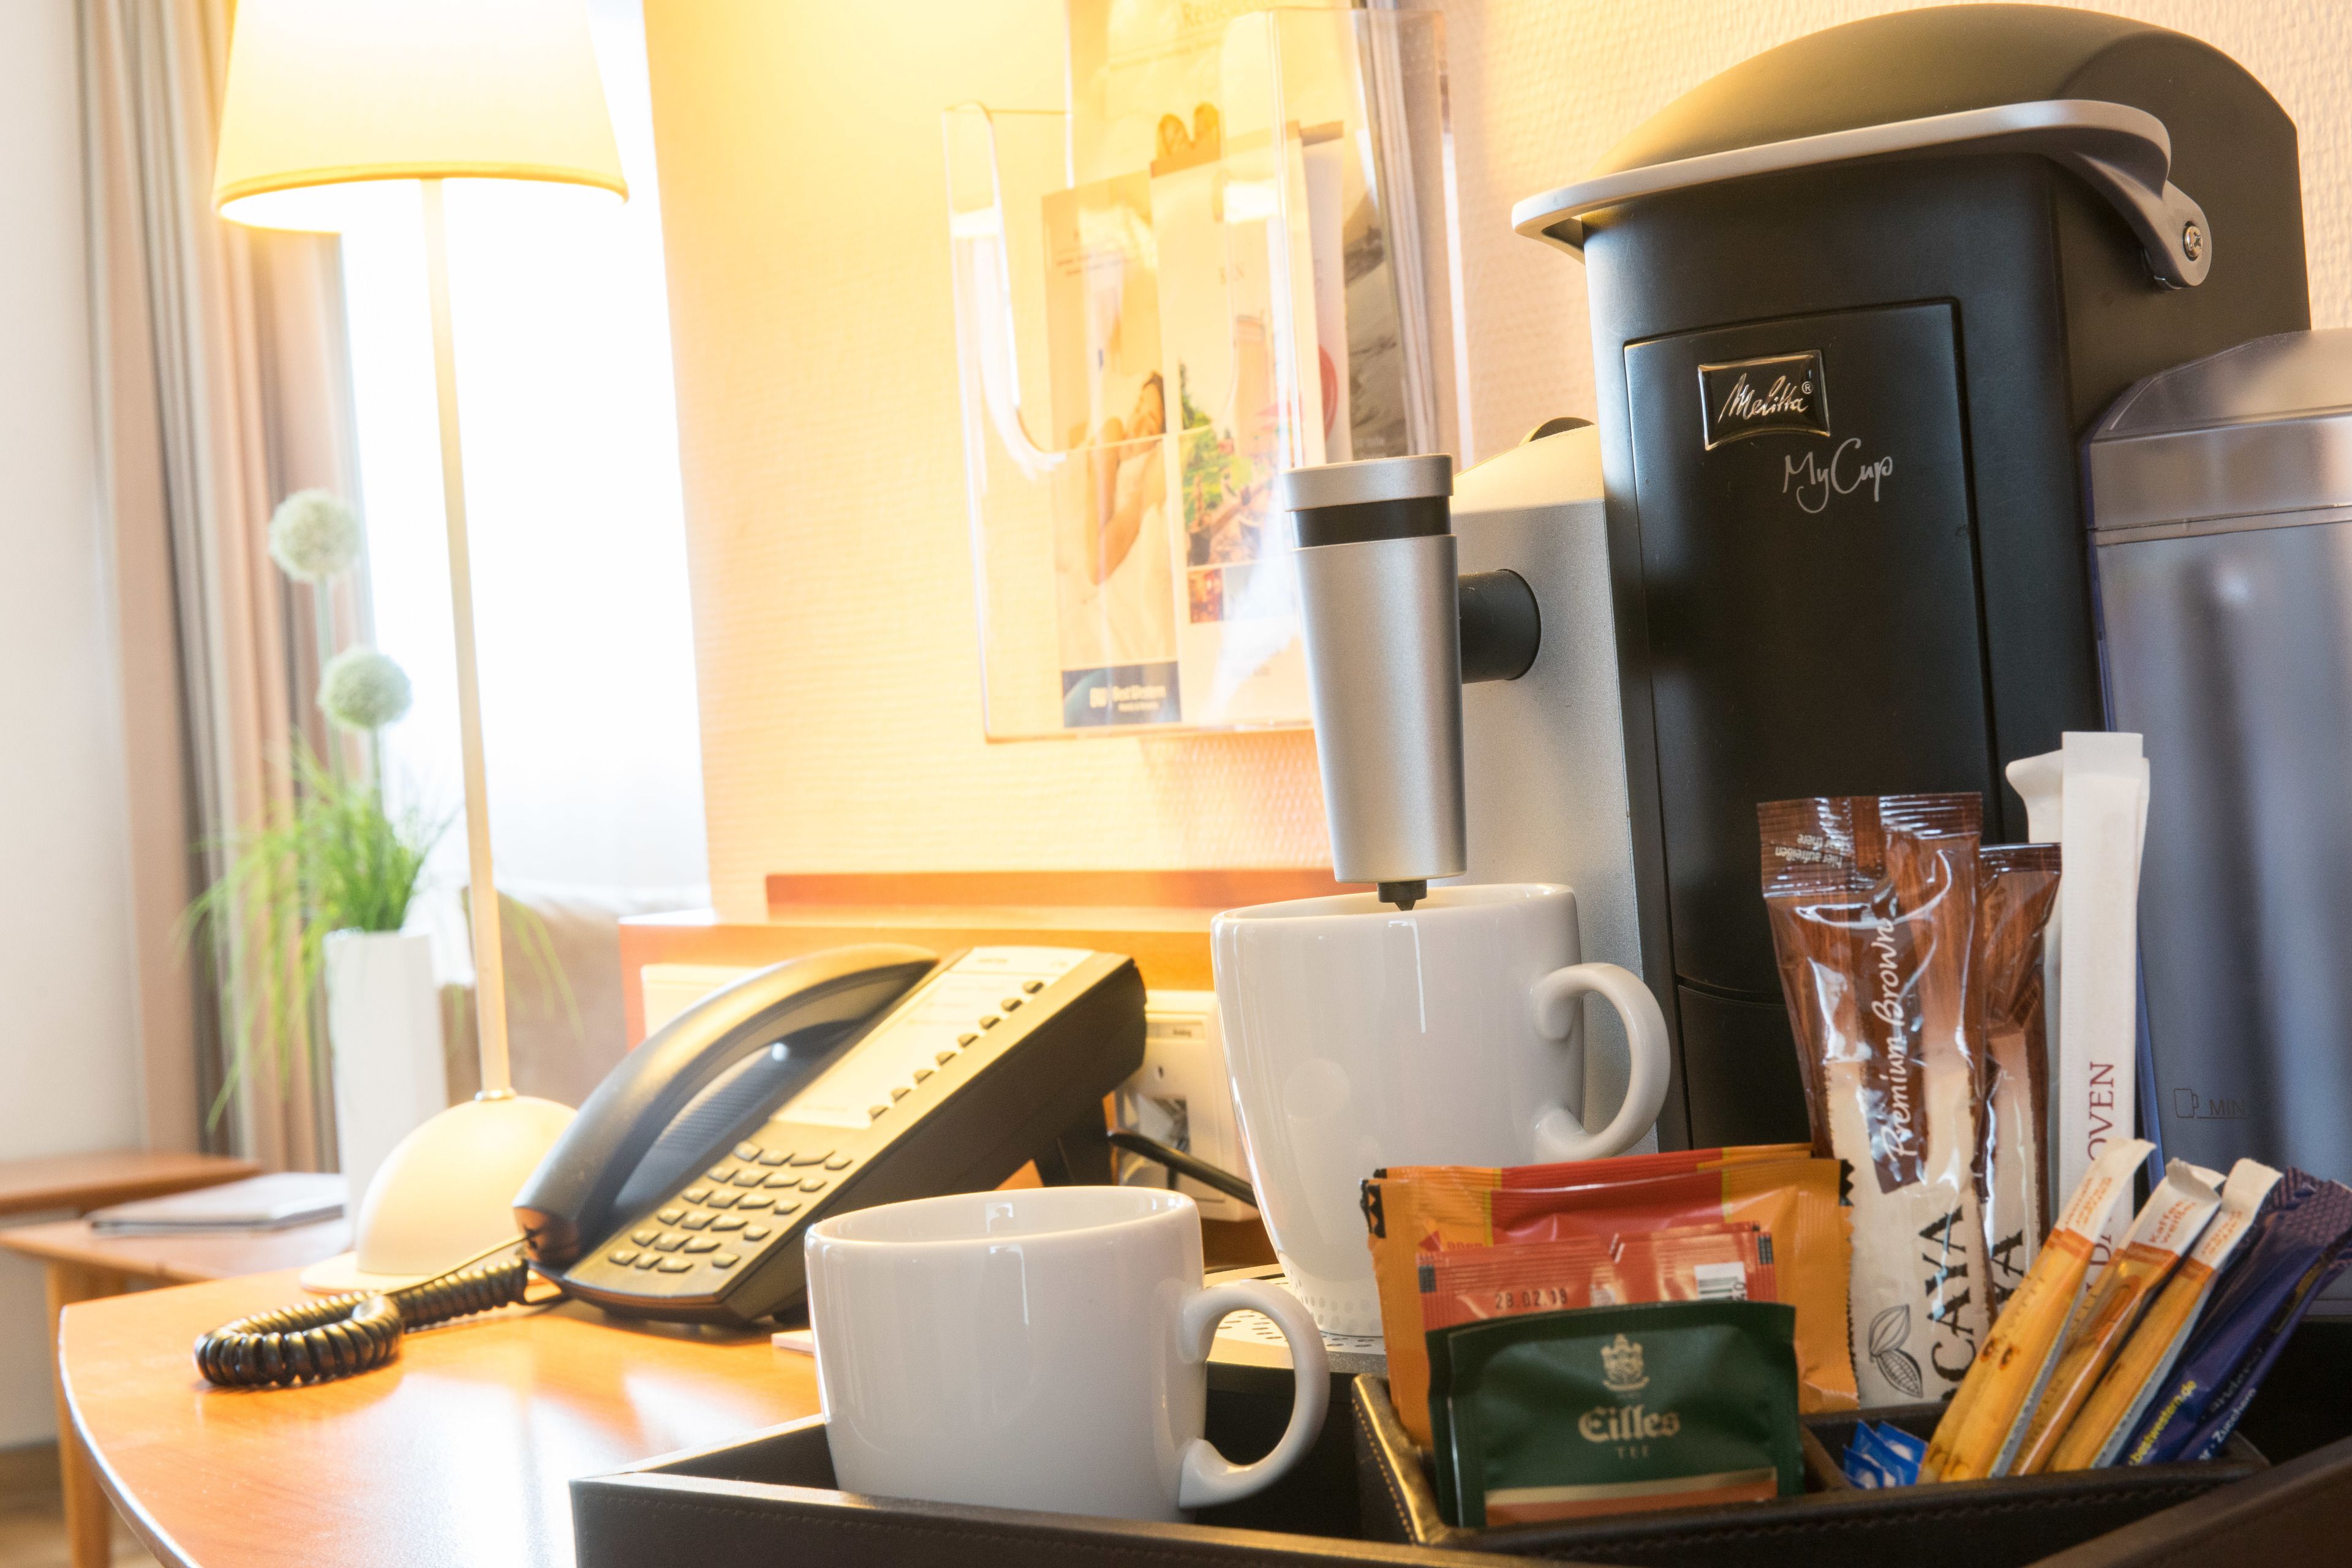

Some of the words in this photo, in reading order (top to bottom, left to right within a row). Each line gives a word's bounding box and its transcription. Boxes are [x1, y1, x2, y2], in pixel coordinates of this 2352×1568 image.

[1871, 916, 1905, 1027] Brown
[1879, 1036, 1918, 1162] Premium
[2209, 1099, 2245, 1115] MIN
[1578, 1404, 1681, 1444] Eilles
